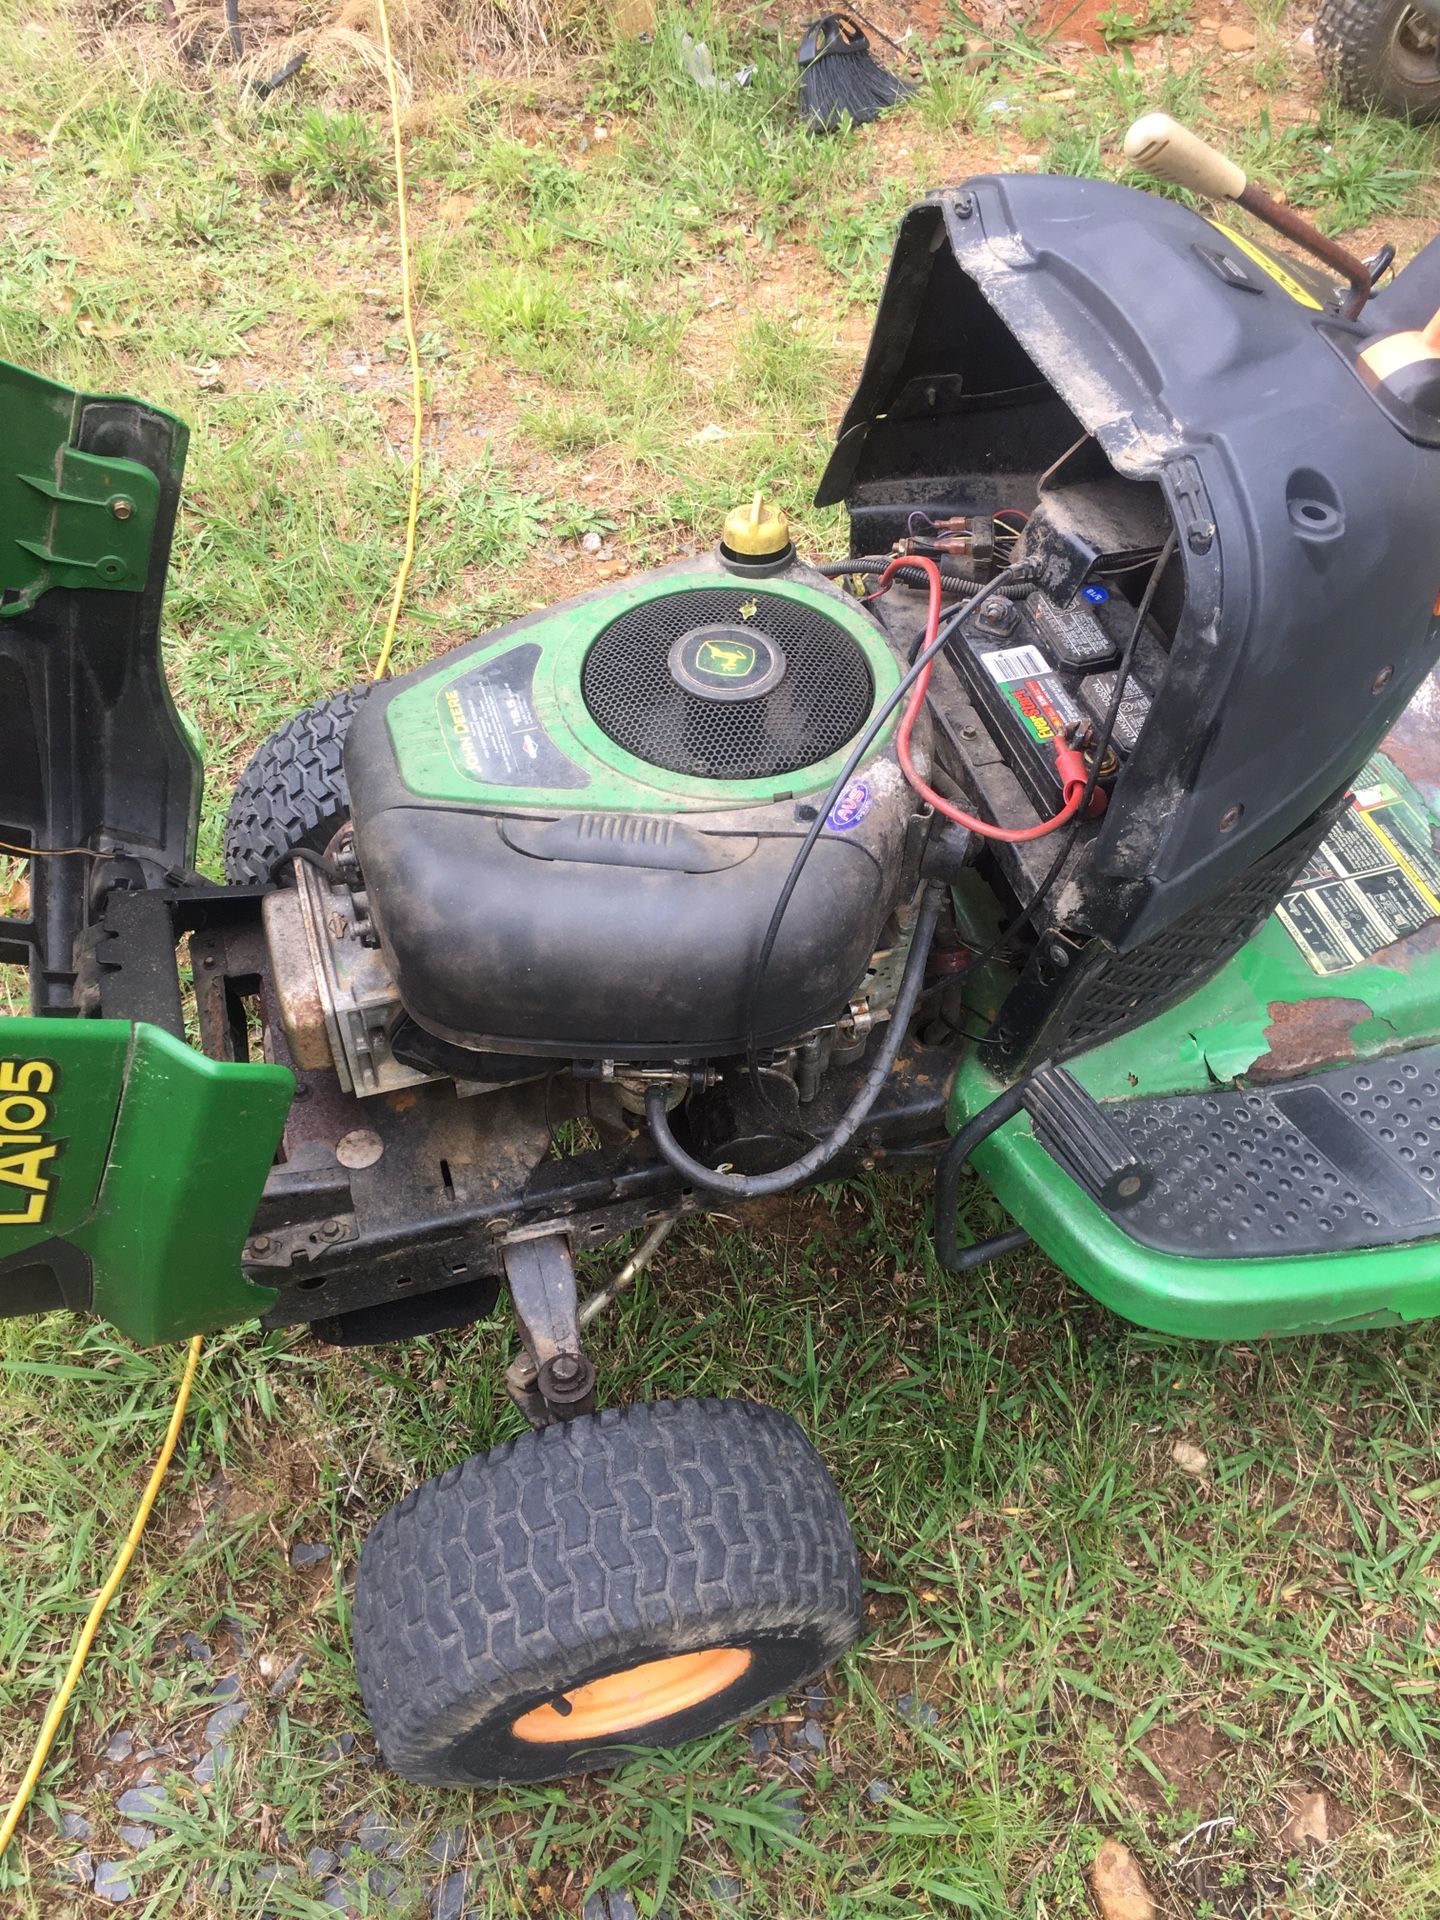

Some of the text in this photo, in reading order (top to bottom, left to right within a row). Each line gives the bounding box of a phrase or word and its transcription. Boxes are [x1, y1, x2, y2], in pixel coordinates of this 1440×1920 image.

[445, 690, 482, 773] JOHN DEERE
[1011, 690, 1054, 739] EverStart
[838, 789, 865, 822] AVS
[0, 1061, 57, 1225] LA105
